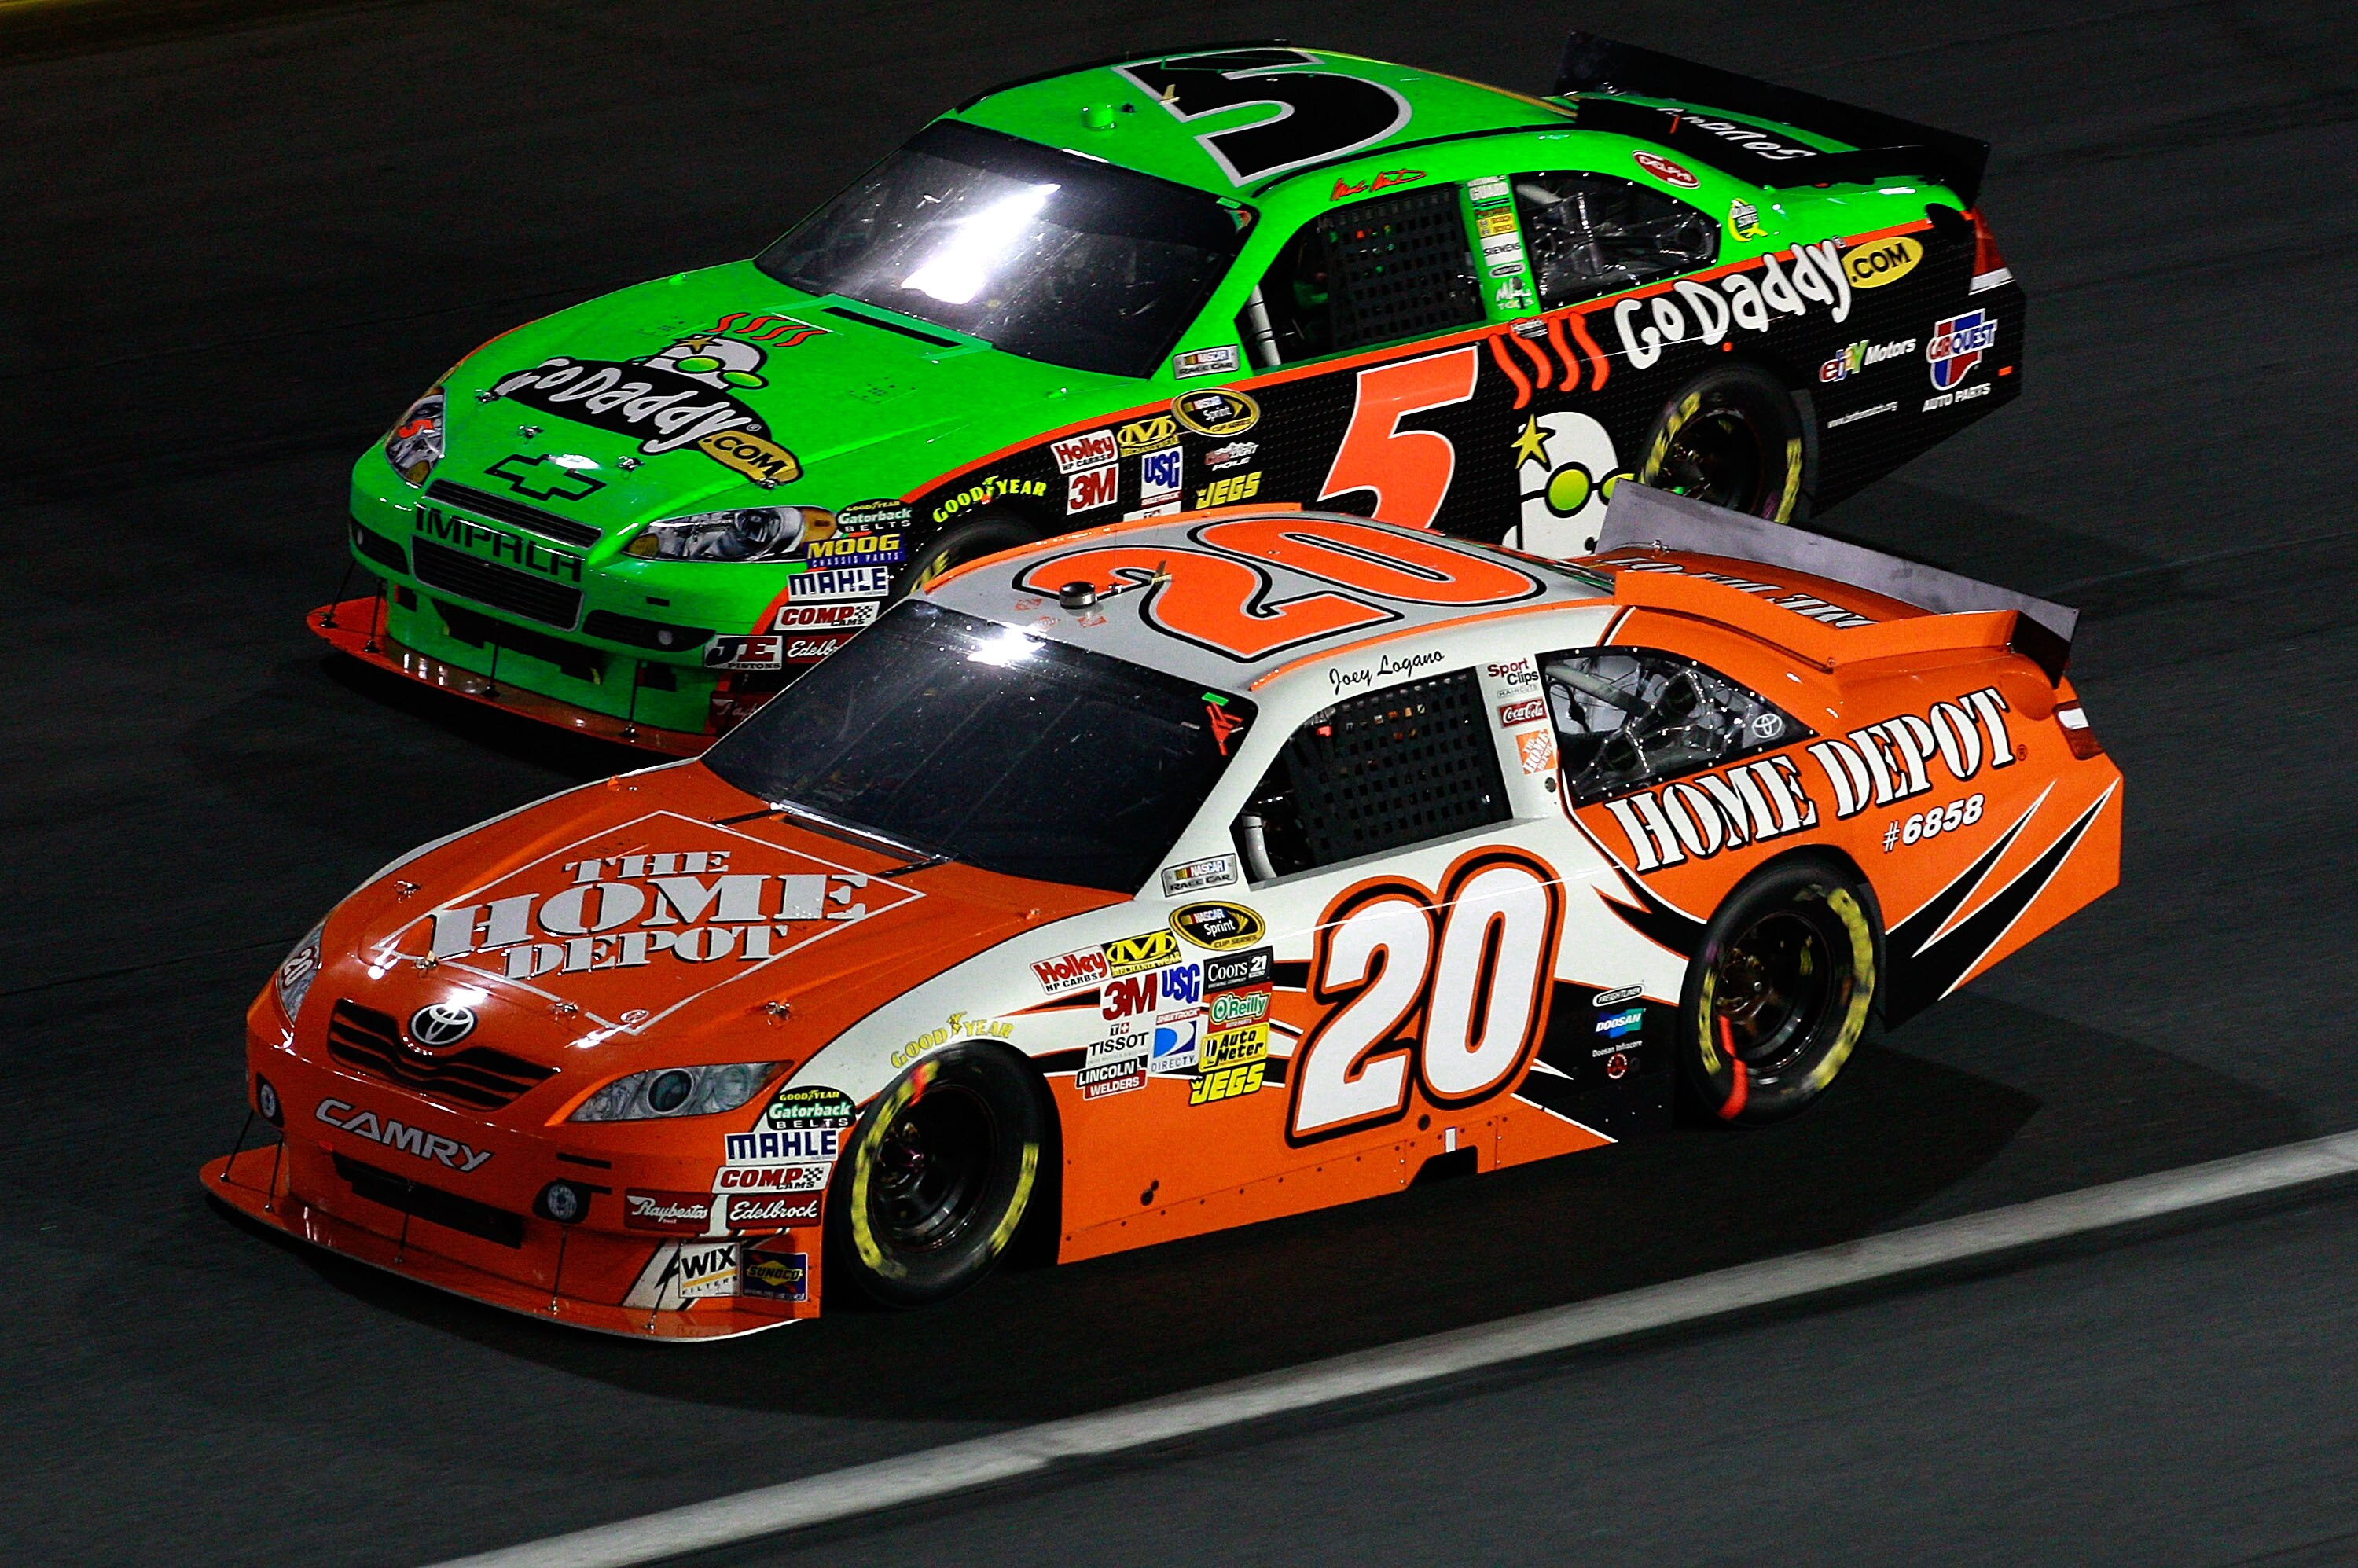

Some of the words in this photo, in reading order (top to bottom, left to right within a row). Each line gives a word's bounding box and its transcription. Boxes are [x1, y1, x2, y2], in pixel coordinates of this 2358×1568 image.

[1110, 47, 1412, 187] 5
[1483, 241, 1522, 257] SIEMENS
[1864, 338, 1918, 366] Motors
[1923, 394, 1954, 412] AUTO
[1955, 383, 1991, 403] PARTS
[1203, 406, 1232, 422] Sprint
[1055, 435, 1115, 462] Holley
[1317, 346, 1478, 529] 5
[1144, 450, 1180, 489] USG
[1212, 457, 1251, 472] POLE
[1069, 468, 1117, 511] 3M
[1196, 470, 1262, 510] JEGS
[838, 507, 912, 525] Gatorback
[844, 520, 912, 533] BELTS
[413, 504, 584, 582] IMPALA
[807, 534, 901, 559] MOOG
[812, 555, 859, 567] CHASSIS
[865, 552, 899, 562] PARTS
[790, 567, 888, 596] MAHLE
[1012, 516, 1547, 663] 20
[780, 605, 854, 626] COMP
[830, 618, 865, 627] CAMS
[707, 637, 777, 664] JE
[787, 638, 839, 658] Edelb
[1329, 668, 1373, 696] Joey
[1377, 650, 1445, 678] Logano
[1487, 658, 1530, 678] Sport
[1507, 670, 1539, 685] Clips
[1605, 753, 1819, 873] HOME
[1808, 686, 2015, 820] DEPOT
[1882, 795, 1985, 853] #6858
[565, 850, 731, 884] THE
[1190, 860, 1225, 876] NASCAR
[1170, 879, 1200, 891] RACE
[1205, 873, 1232, 884] CAR
[429, 873, 871, 960] HOME
[1192, 909, 1225, 921] NASCAR
[1203, 918, 1236, 938] Sprint
[501, 924, 788, 979] DEPOT
[1214, 939, 1229, 949] CUP
[282, 946, 316, 988] 20
[1032, 951, 1108, 982] Holley
[1207, 961, 1248, 982] Coors
[1250, 954, 1267, 973] 21
[1046, 982, 1058, 993] HP
[1059, 971, 1099, 990] CARBS
[1162, 964, 1201, 1004] USG
[1103, 972, 1158, 1021] 3M
[1212, 993, 1269, 1022] O'Reilly
[1289, 853, 1558, 1144] 20
[1595, 1012, 1642, 1032] DOOSAN
[1089, 1032, 1149, 1057] TISSOT
[1220, 1030, 1257, 1048] Auto
[1218, 1041, 1264, 1063] Meter
[1592, 1047, 1615, 1057] Doosan
[1079, 1060, 1136, 1085] LINCOLN
[1190, 1062, 1266, 1106] JEGS
[780, 1090, 840, 1101] GOODYEAR
[1090, 1076, 1140, 1096] WELDERS
[769, 1101, 854, 1120] Gatorback
[315, 1098, 494, 1172] CAMRY
[776, 1118, 849, 1129] BELTS
[727, 1129, 836, 1159] MAHLE
[719, 1168, 803, 1188] COMP
[776, 1181, 815, 1190] CAMS
[729, 1199, 818, 1221] Edelbrock
[681, 1244, 736, 1280] WIX
[748, 1265, 801, 1281] SUNOCO
[682, 1276, 738, 1295] FILTERS
